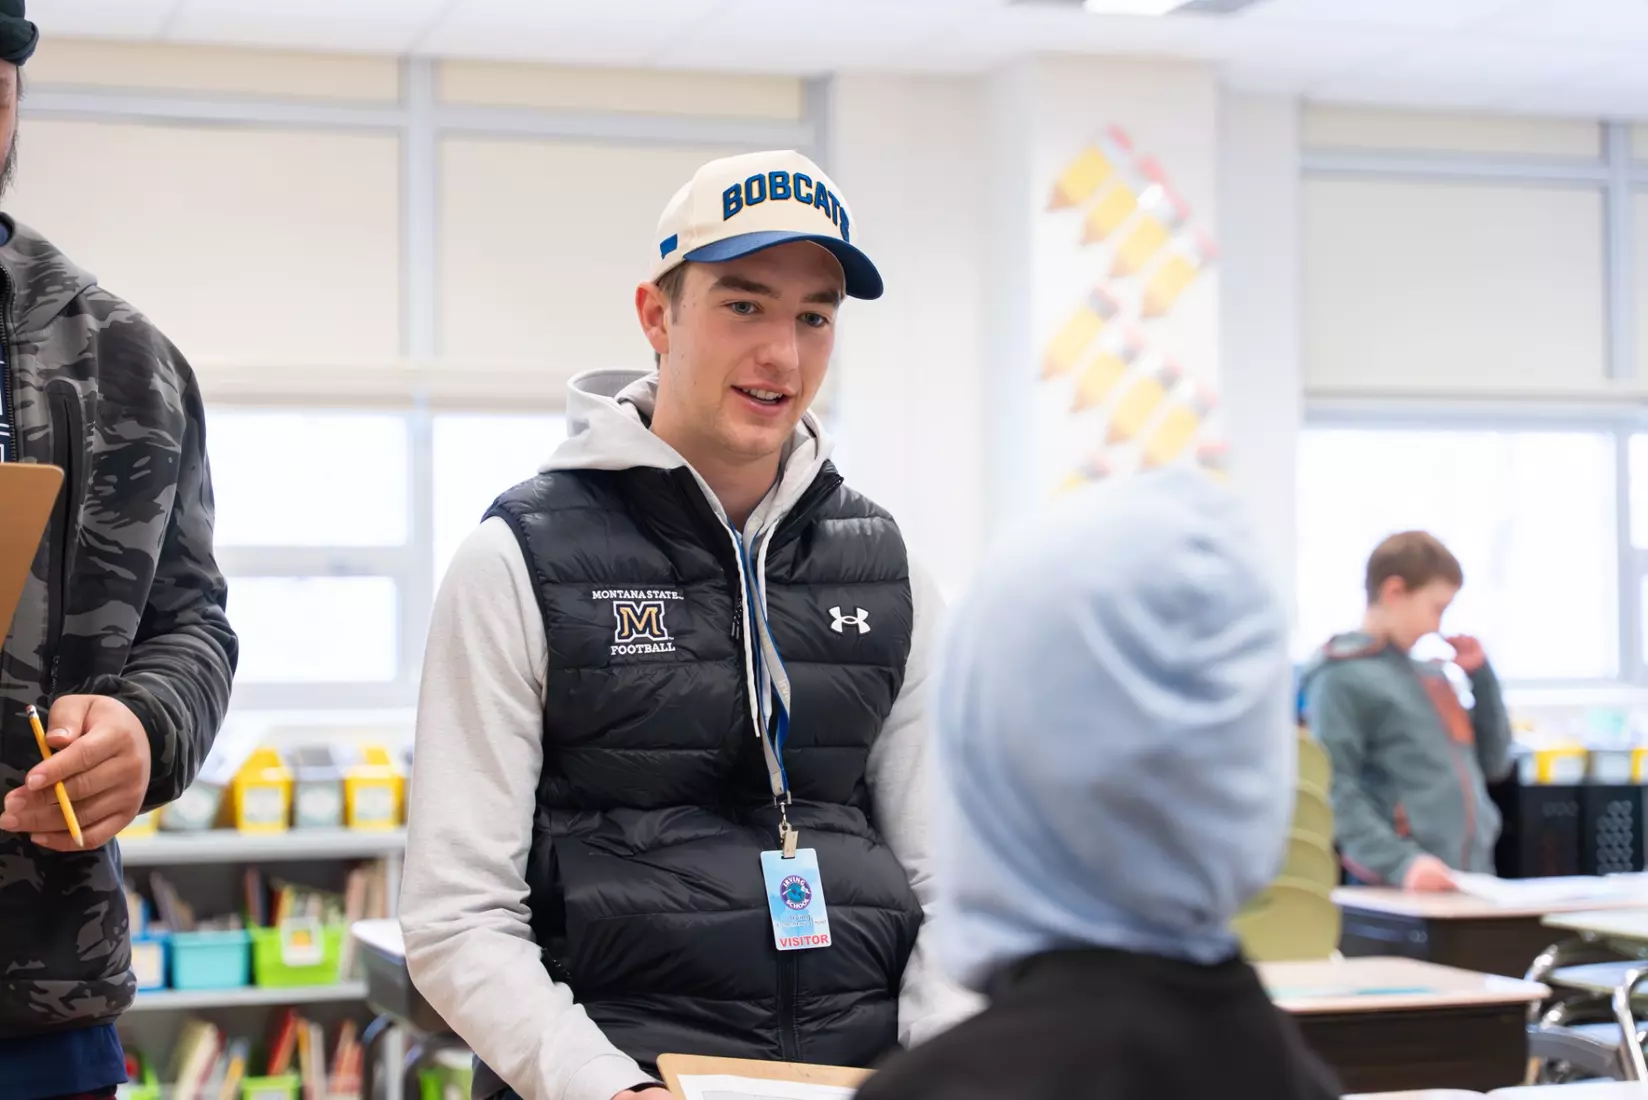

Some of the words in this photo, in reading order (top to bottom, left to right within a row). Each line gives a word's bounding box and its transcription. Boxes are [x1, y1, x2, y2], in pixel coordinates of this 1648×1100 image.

[592, 590, 646, 599] MONTANA
[647, 590, 678, 599] STATE
[613, 601, 668, 642] M
[611, 642, 676, 655] FOOTBALL
[783, 876, 805, 887] IRVING
[780, 934, 829, 947] VISITOR
